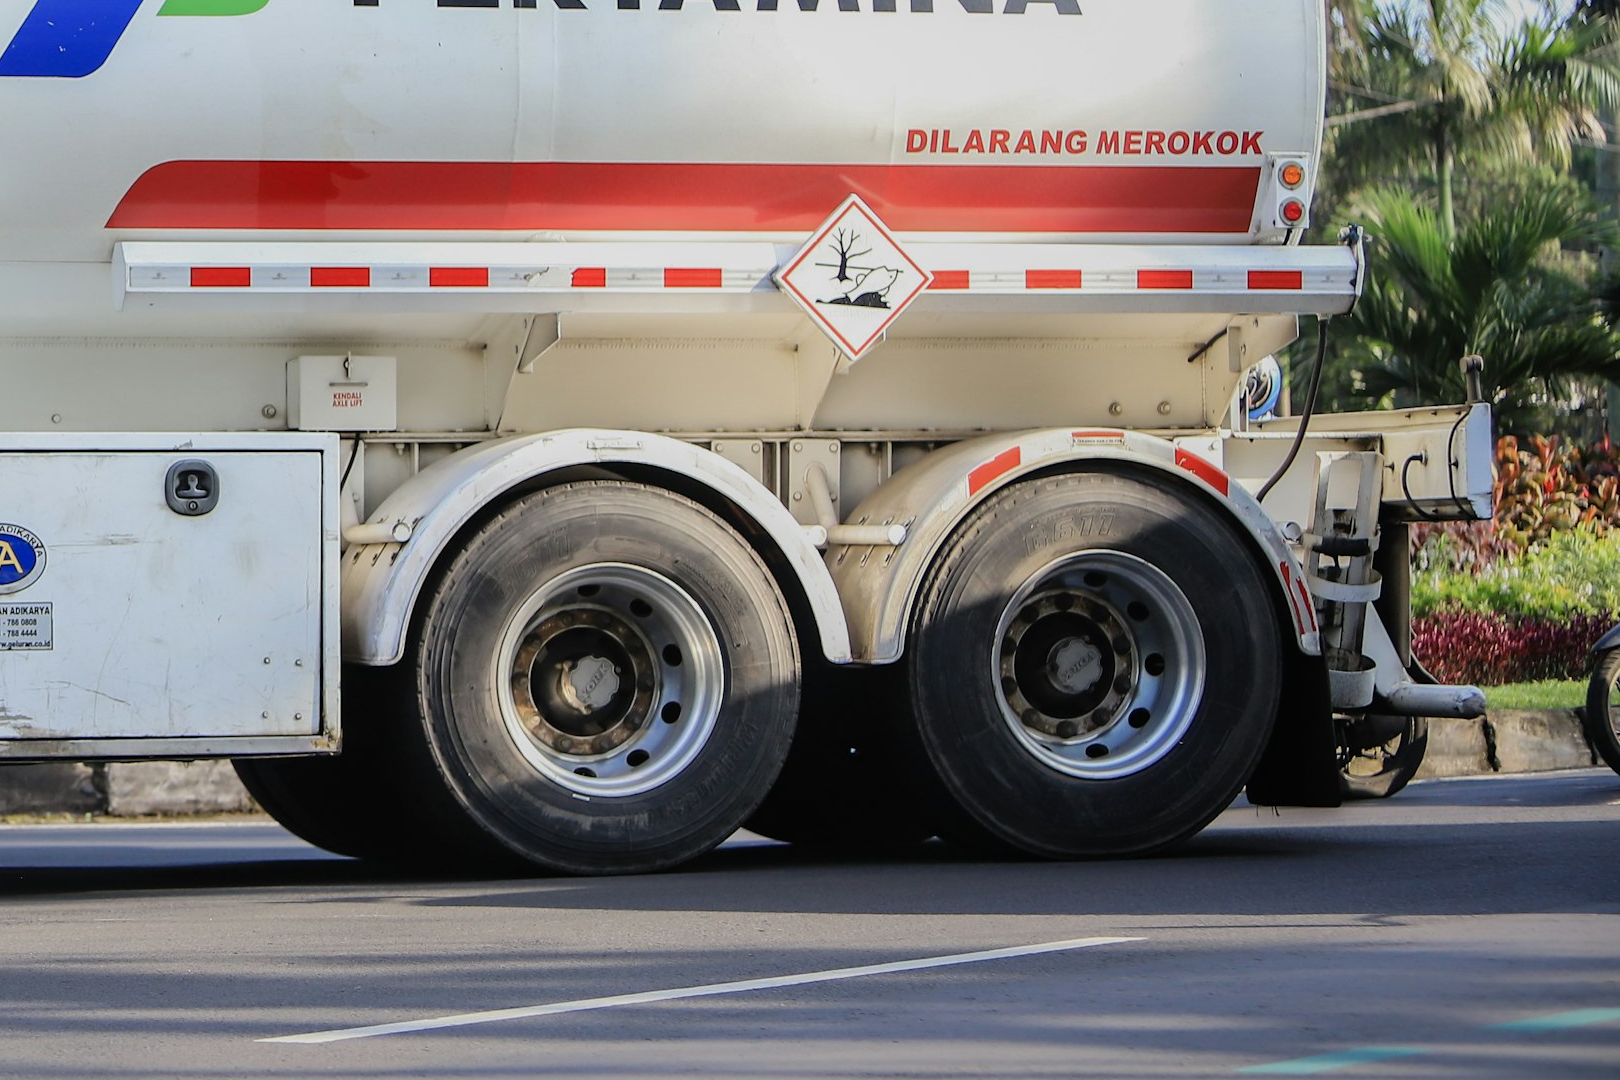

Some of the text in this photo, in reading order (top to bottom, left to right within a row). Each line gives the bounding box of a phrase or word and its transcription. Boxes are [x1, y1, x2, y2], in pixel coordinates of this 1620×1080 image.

[905, 128, 1265, 156] DILARANG MEROKOK
[0, 525, 44, 558] ADIKARYA
[10, 606, 50, 615] ADIKARYA
